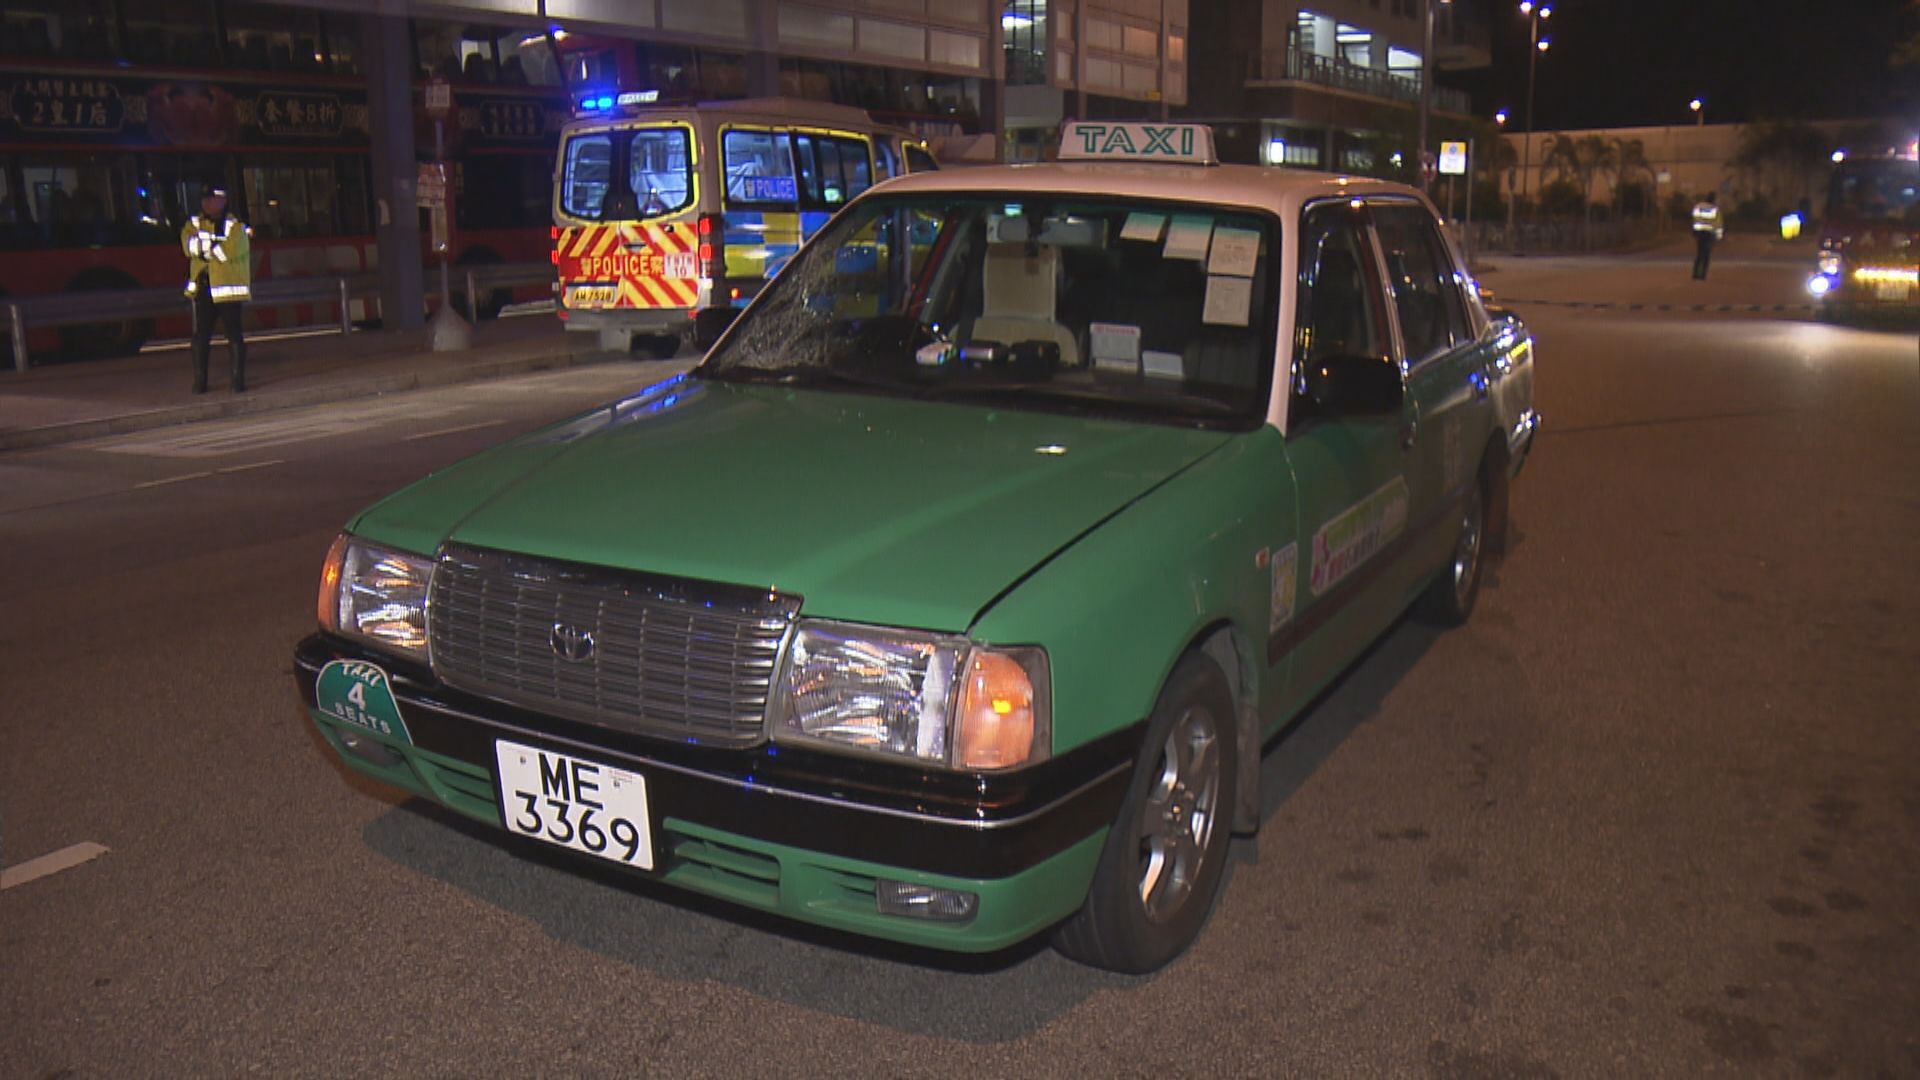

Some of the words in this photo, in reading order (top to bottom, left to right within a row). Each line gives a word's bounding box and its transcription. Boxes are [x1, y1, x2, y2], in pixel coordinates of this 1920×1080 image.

[1076, 126, 1194, 155] TAXI
[757, 180, 793, 198] POLICE
[593, 255, 648, 277] POLICE
[342, 663, 381, 686] TAXI
[348, 682, 366, 711] 4
[335, 702, 391, 734] SEATS
[539, 752, 603, 811] ME
[515, 790, 640, 862] 3369
